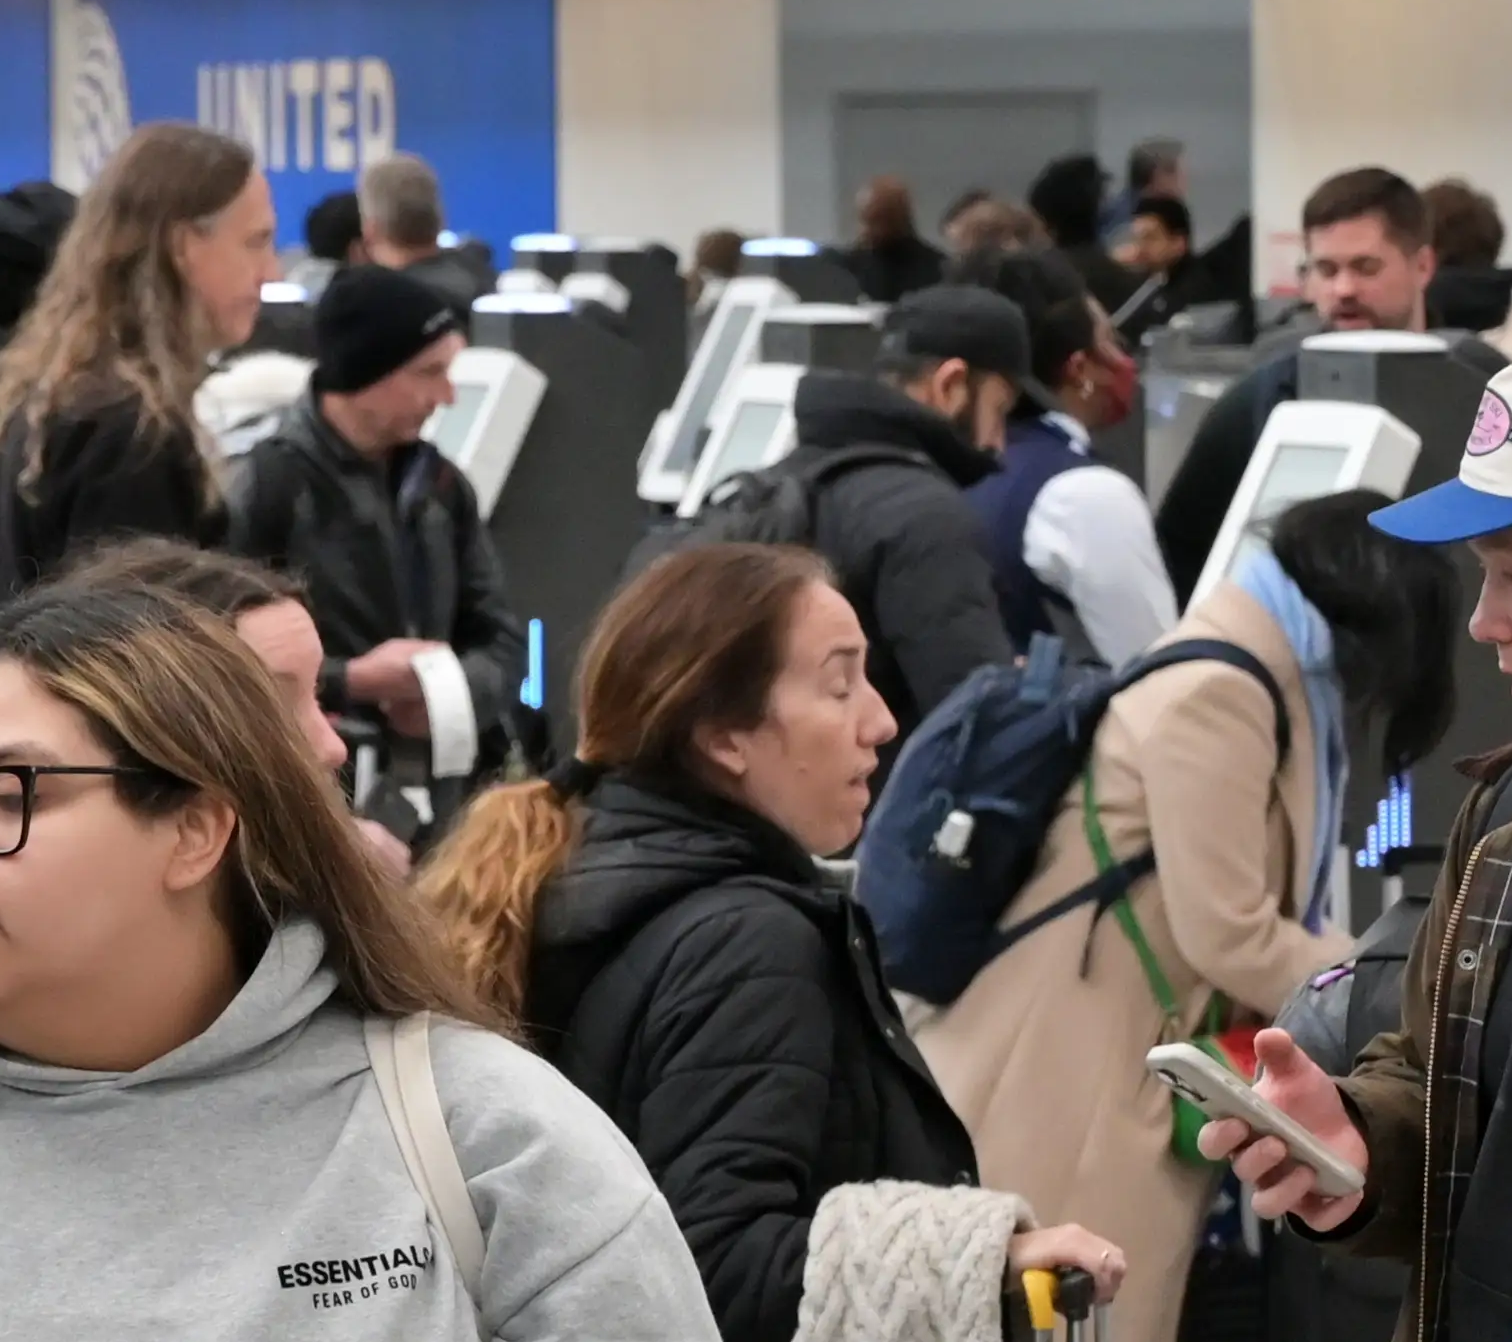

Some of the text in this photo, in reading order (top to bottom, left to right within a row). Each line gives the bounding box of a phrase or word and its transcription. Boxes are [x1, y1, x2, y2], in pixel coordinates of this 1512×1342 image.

[198, 57, 396, 172] UNITED
[313, 1274, 417, 1309] FEAR OF GOD
